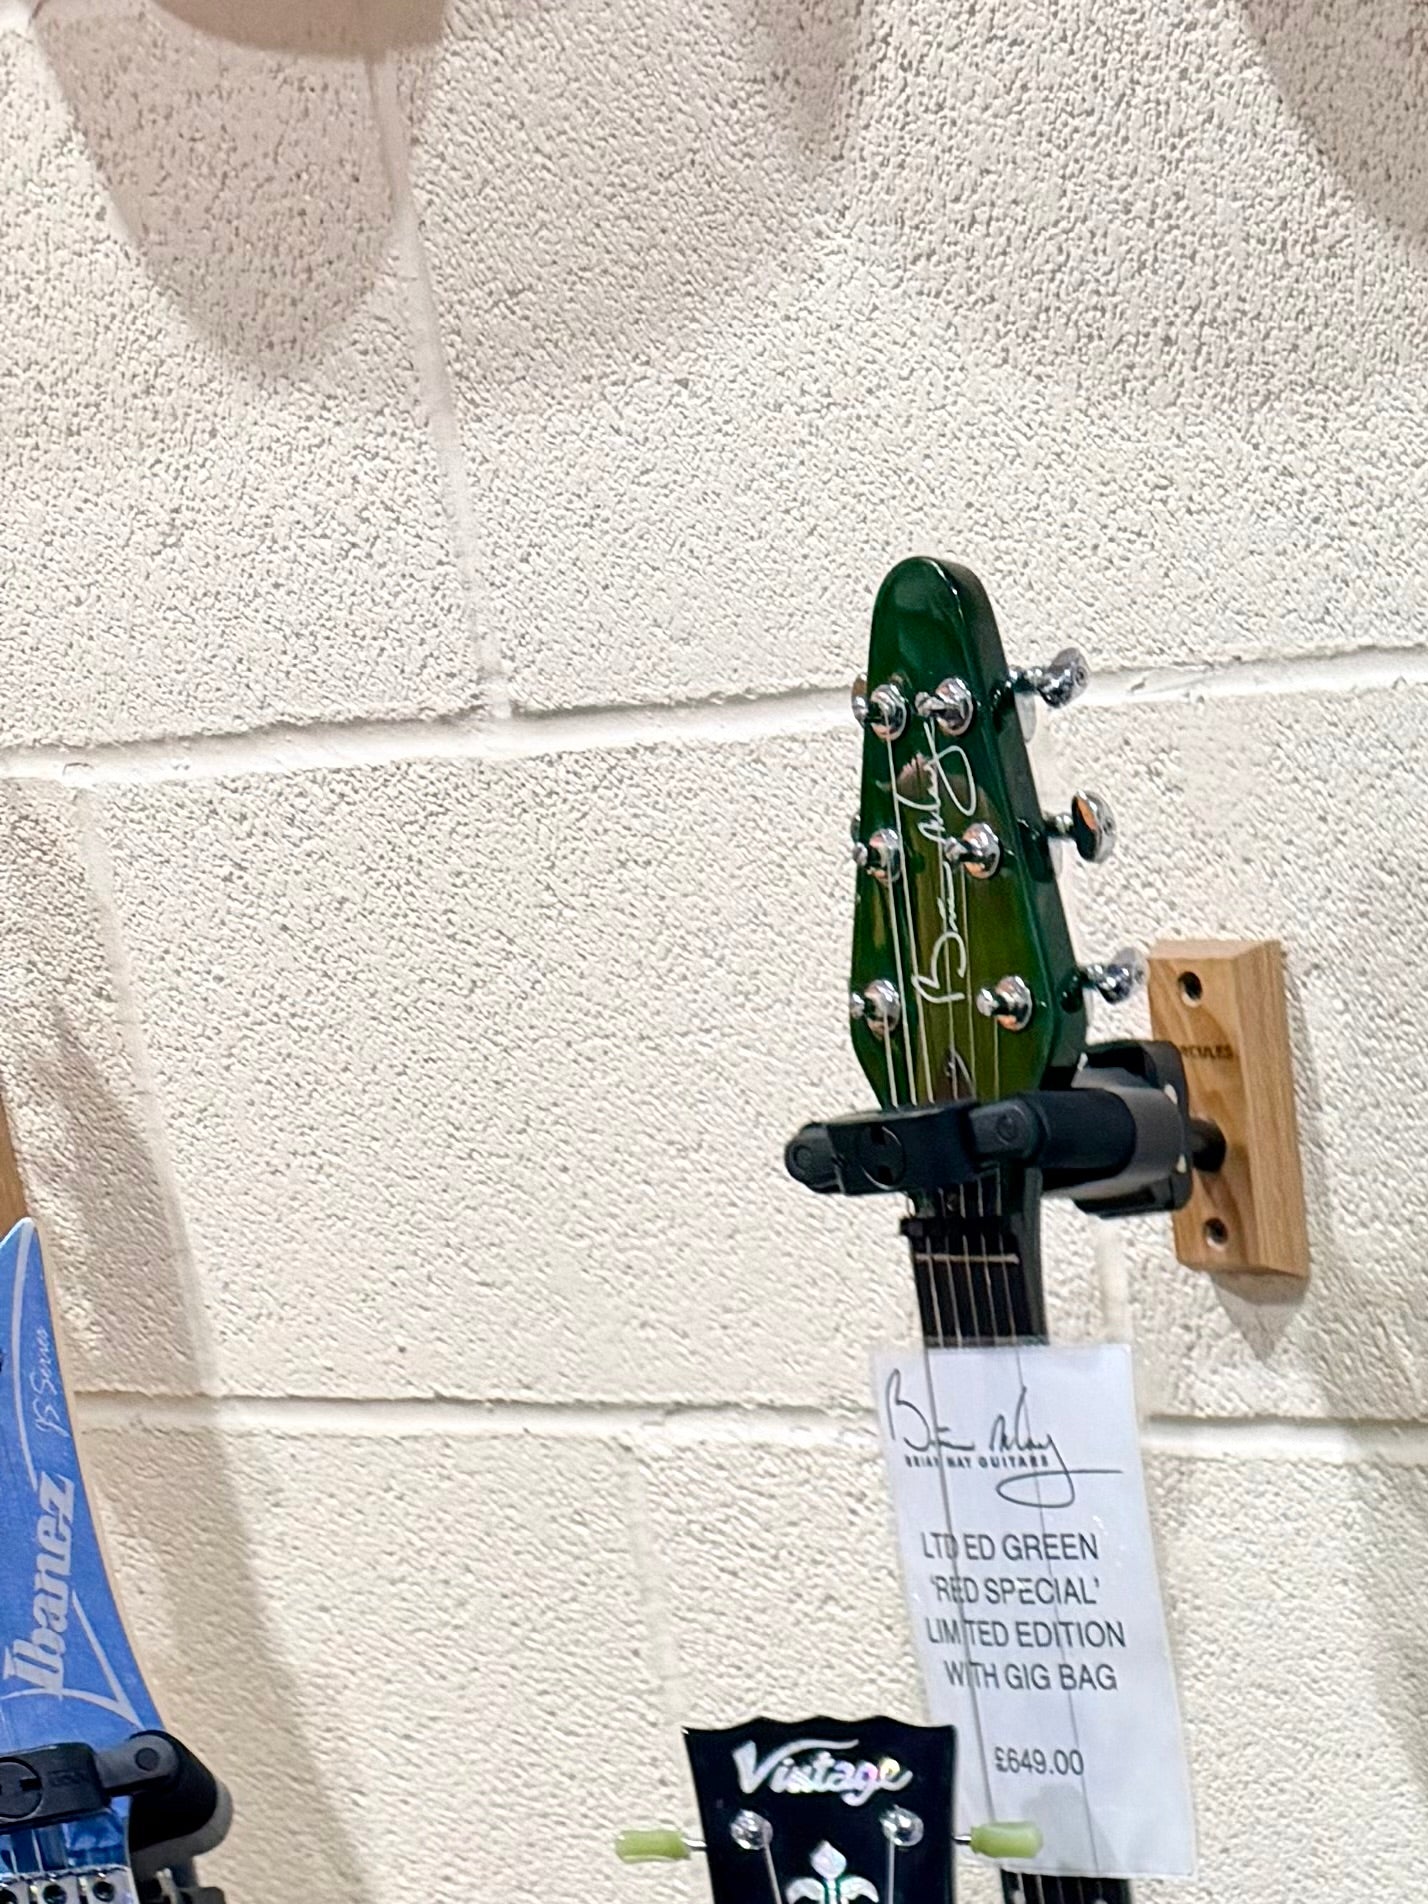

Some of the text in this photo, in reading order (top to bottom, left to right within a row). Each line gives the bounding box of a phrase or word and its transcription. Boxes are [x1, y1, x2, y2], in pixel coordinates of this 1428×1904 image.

[978, 1456, 1050, 1469] GUITARS
[921, 1531, 1099, 1561] LTD ED GREEN
[4, 1472, 76, 1698] Ibanez
[927, 1618, 1127, 1648] LIMITED EDITION
[944, 1660, 1118, 1692] WITH GIG BAG
[732, 1738, 912, 1806] Vintage
[994, 1748, 1085, 1776] £649.00
